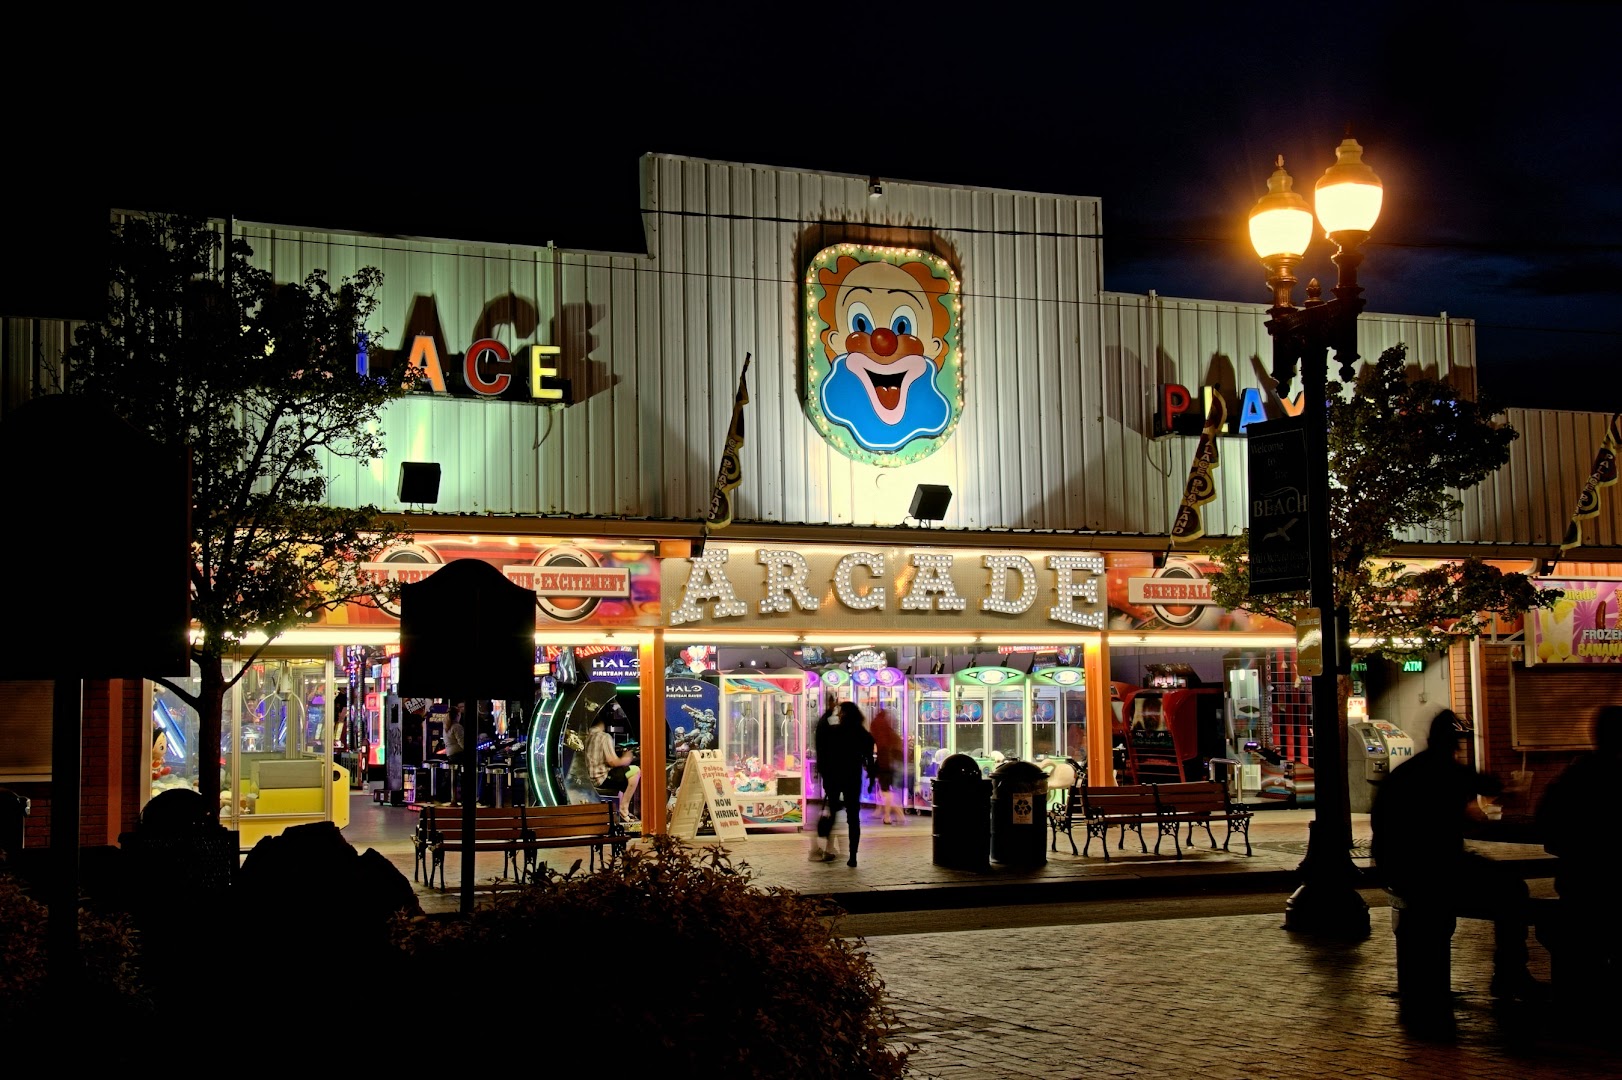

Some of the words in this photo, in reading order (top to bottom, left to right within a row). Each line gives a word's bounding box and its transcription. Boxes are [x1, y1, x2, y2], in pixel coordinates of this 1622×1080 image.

[1253, 494, 1308, 518] BEACH
[541, 573, 626, 592] EXCITEMENT
[669, 548, 1107, 630] ARCADE
[592, 658, 641, 668] HALO
[1403, 661, 1423, 672] ATM
[1391, 747, 1412, 756] ATM
[702, 771, 729, 779] Playland
[714, 798, 732, 807] NOW
[714, 809, 739, 819] HIRING
